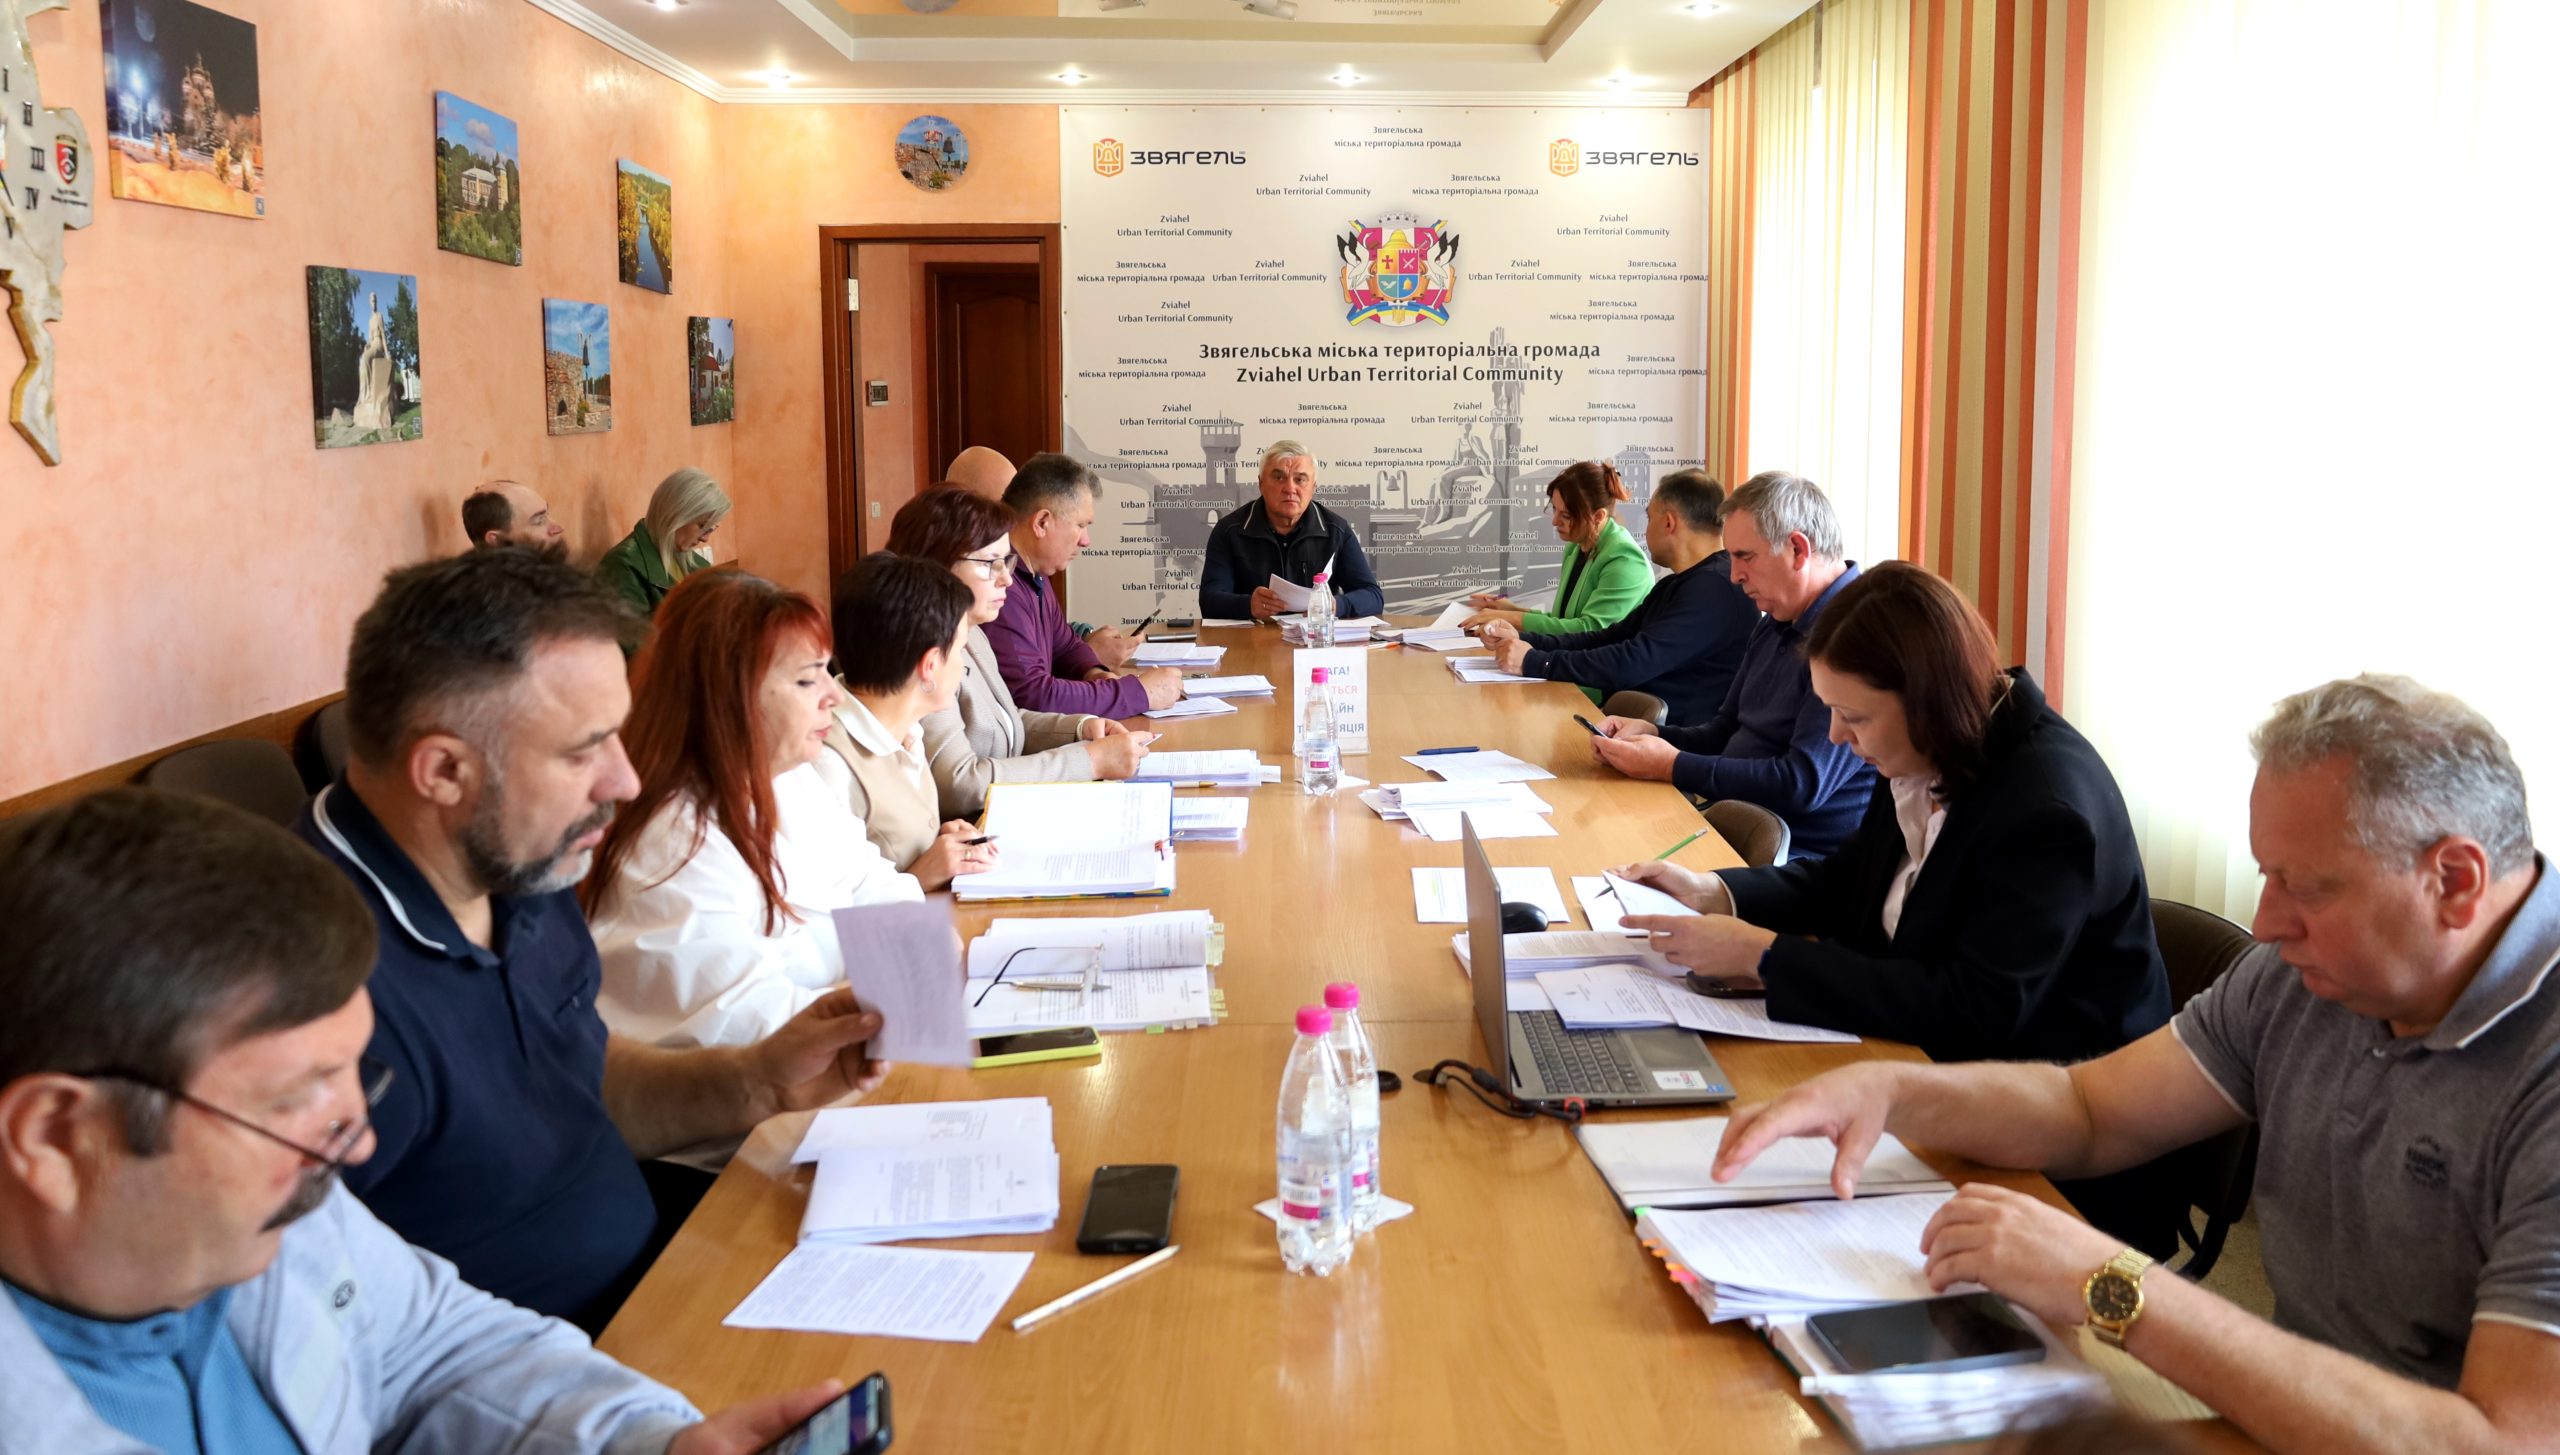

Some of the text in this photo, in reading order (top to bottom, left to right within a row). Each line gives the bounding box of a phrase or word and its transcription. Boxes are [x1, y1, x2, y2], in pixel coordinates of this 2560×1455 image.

[1373, 126, 1423, 135] Звягельська
[1334, 139, 1361, 147] міська
[1364, 139, 1424, 148] територіальна
[31, 146, 45, 171] III
[1299, 174, 1328, 182] Zviahel
[1451, 174, 1501, 182] Звягельська
[1256, 187, 1371, 197] Urban Territorial Community
[1442, 187, 1501, 196] територіальна
[25, 187, 39, 210] IV
[1160, 215, 1189, 223] Zviahel
[1600, 214, 1628, 223] Zviahel
[1117, 228, 1232, 238] Urban Territorial Community
[1557, 227, 1670, 237] Urban Territorial Community
[1116, 261, 1166, 269] Звягельська
[1255, 260, 1284, 269] Zviahel
[1511, 259, 1540, 267] Zviahel
[1627, 260, 1677, 268] Звягельська
[1077, 274, 1104, 282] міська
[1107, 274, 1167, 283] територіальна
[1212, 273, 1327, 283] Urban Territorial Community
[1468, 272, 1582, 282] Urban Territorial Community
[1619, 273, 1679, 282] територіальна
[1161, 301, 1190, 309] Zviahel
[1588, 299, 1637, 308] Звягельська
[1118, 314, 1233, 324] Urban Territorial Community
[1550, 312, 1576, 320] міська
[1579, 312, 1638, 321] територіальна
[1199, 341, 1600, 361] Звягельська міська територіальна громада
[1117, 357, 1167, 365] Звягельська
[1627, 355, 1675, 363] Звягельська
[1079, 370, 1106, 378] міська
[1108, 370, 1168, 379] територіальна
[1237, 366, 1563, 385] Zviahel Urban Territorial Community
[1588, 367, 1615, 375] міська
[1618, 367, 1678, 376] територіальна
[1162, 404, 1192, 413] Zviahel
[1297, 403, 1347, 411] Звягельська
[1453, 402, 1482, 410] Zviahel
[1587, 402, 1636, 410] Звягельська
[1120, 417, 1235, 426] Urban Territorial Community
[1259, 416, 1286, 424] міська
[1289, 416, 1348, 425] територіальна
[1411, 415, 1524, 425] Urban Territorial Community
[1549, 414, 1673, 424] міська територіальна громада
[1118, 448, 1168, 457] Звягельська
[1374, 446, 1423, 454] Звягельська
[1510, 445, 1538, 453] Zviahel
[1626, 445, 1674, 453] Звягельська
[1111, 461, 1169, 471] територіальна
[1365, 459, 1423, 468] територіальна
[1426, 460, 1460, 468] громада
[1467, 458, 1490, 466] Urban
[1494, 458, 1532, 466] Territorial
[1616, 457, 1674, 466] територіальна
[1535, 544, 1564, 552] Commu
[1122, 582, 1146, 591] Urban
[1150, 582, 1190, 591] Territorial
